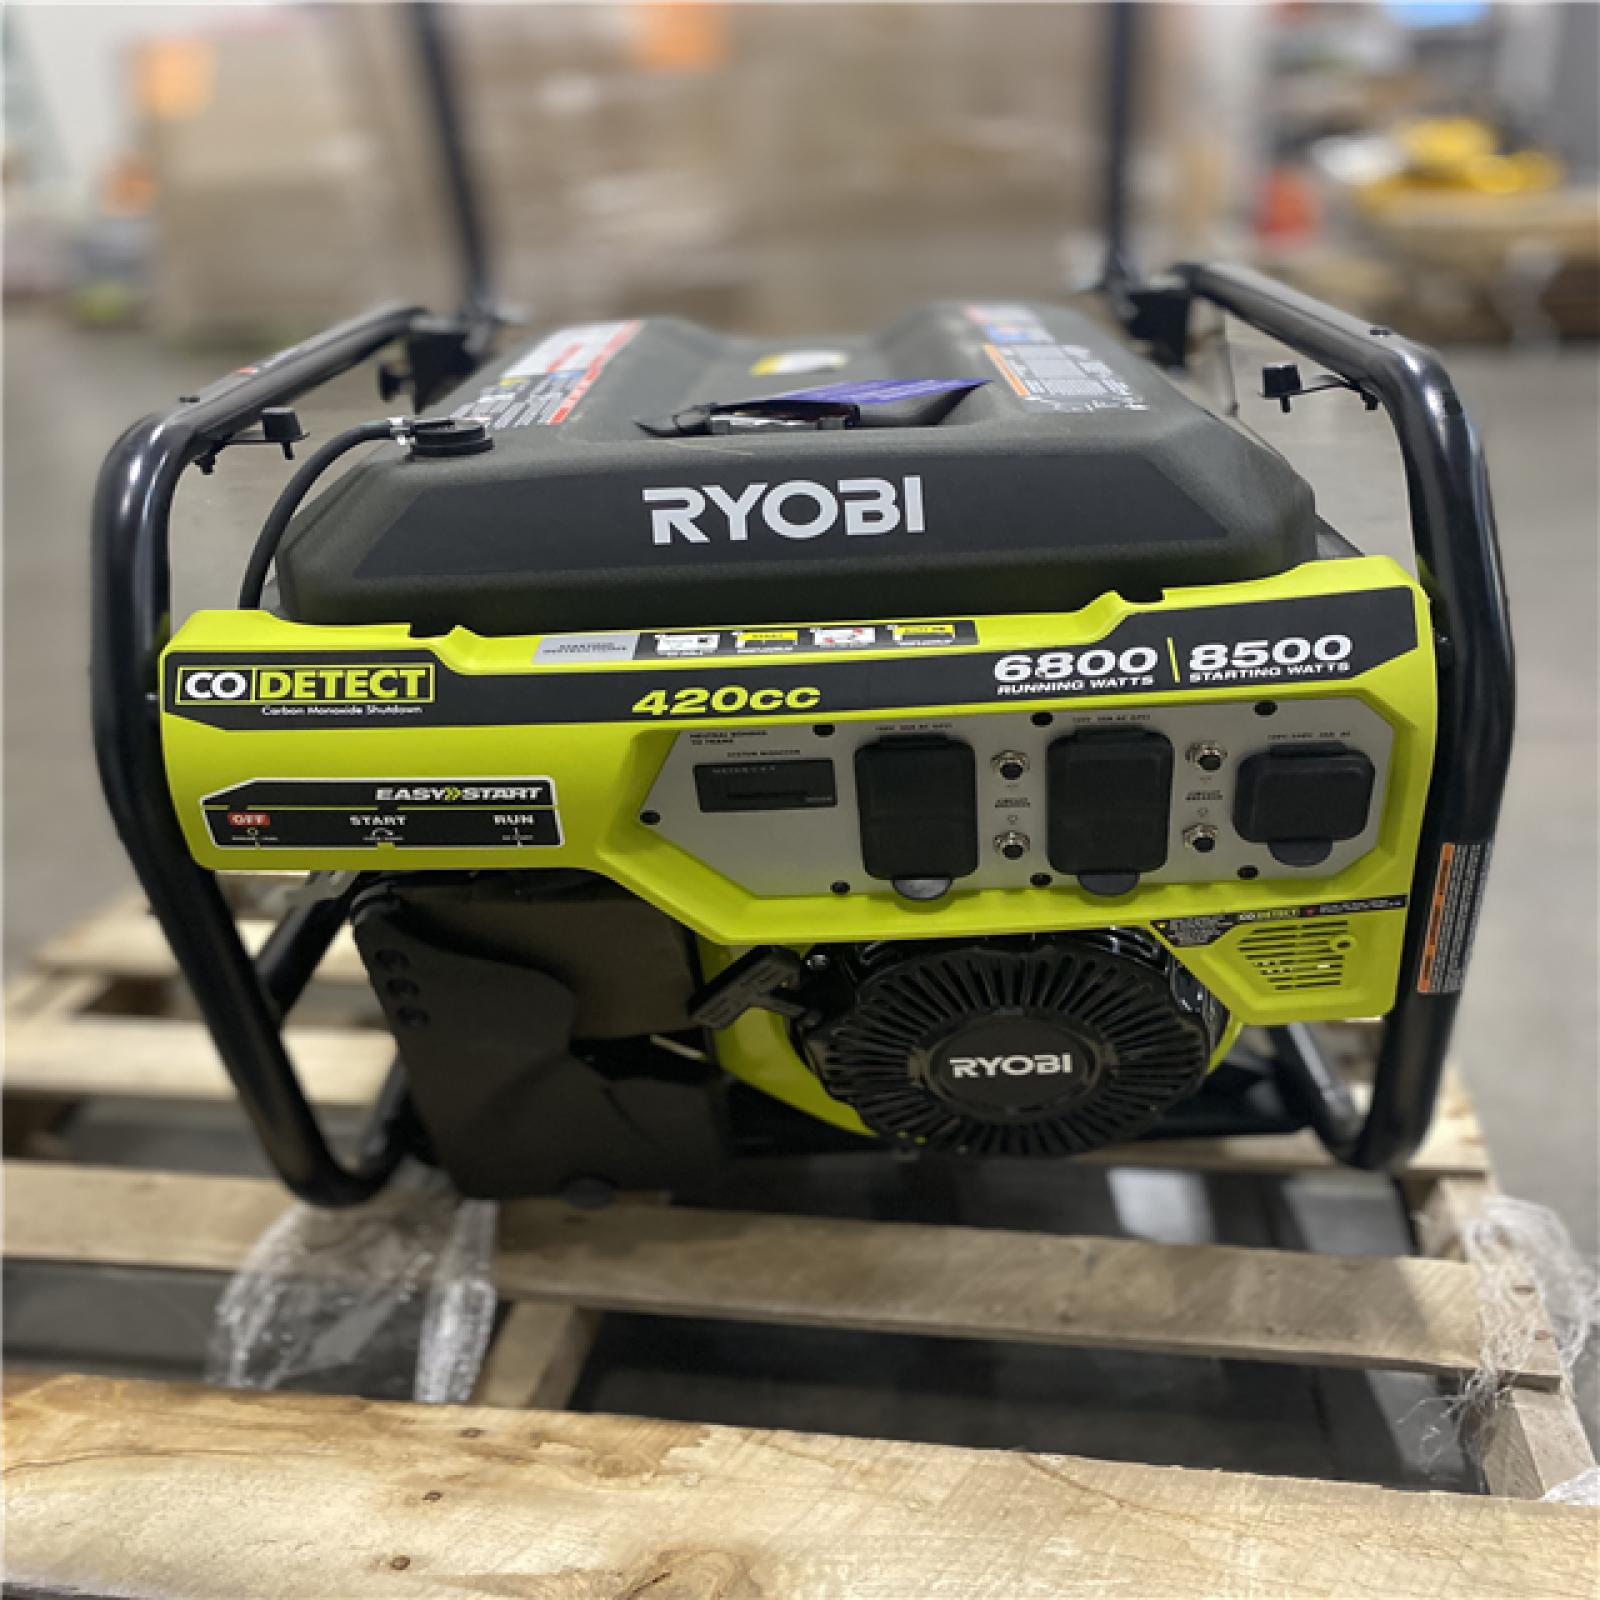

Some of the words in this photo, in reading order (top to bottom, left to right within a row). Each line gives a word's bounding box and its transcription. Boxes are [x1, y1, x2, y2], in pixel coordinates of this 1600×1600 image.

[642, 475, 926, 545] RYOBI
[994, 647, 1158, 682] 6800
[1189, 635, 1353, 671] 8500
[1189, 668, 1281, 683] STARTING
[1287, 661, 1350, 675] WATTS
[184, 671, 248, 698] CO
[259, 669, 427, 698] DETECT
[997, 680, 1085, 696] RUNNING
[1089, 674, 1154, 688] WATTS
[262, 704, 305, 716] Carbon
[306, 704, 364, 716] Monoxide
[366, 704, 423, 715] Shutdown
[632, 685, 821, 716] 420cc
[376, 786, 446, 801] EASY
[462, 786, 543, 801] START
[231, 814, 266, 826] OFF
[349, 814, 406, 827] START
[493, 814, 535, 825] RUN
[949, 1051, 1074, 1079] RYOBI
